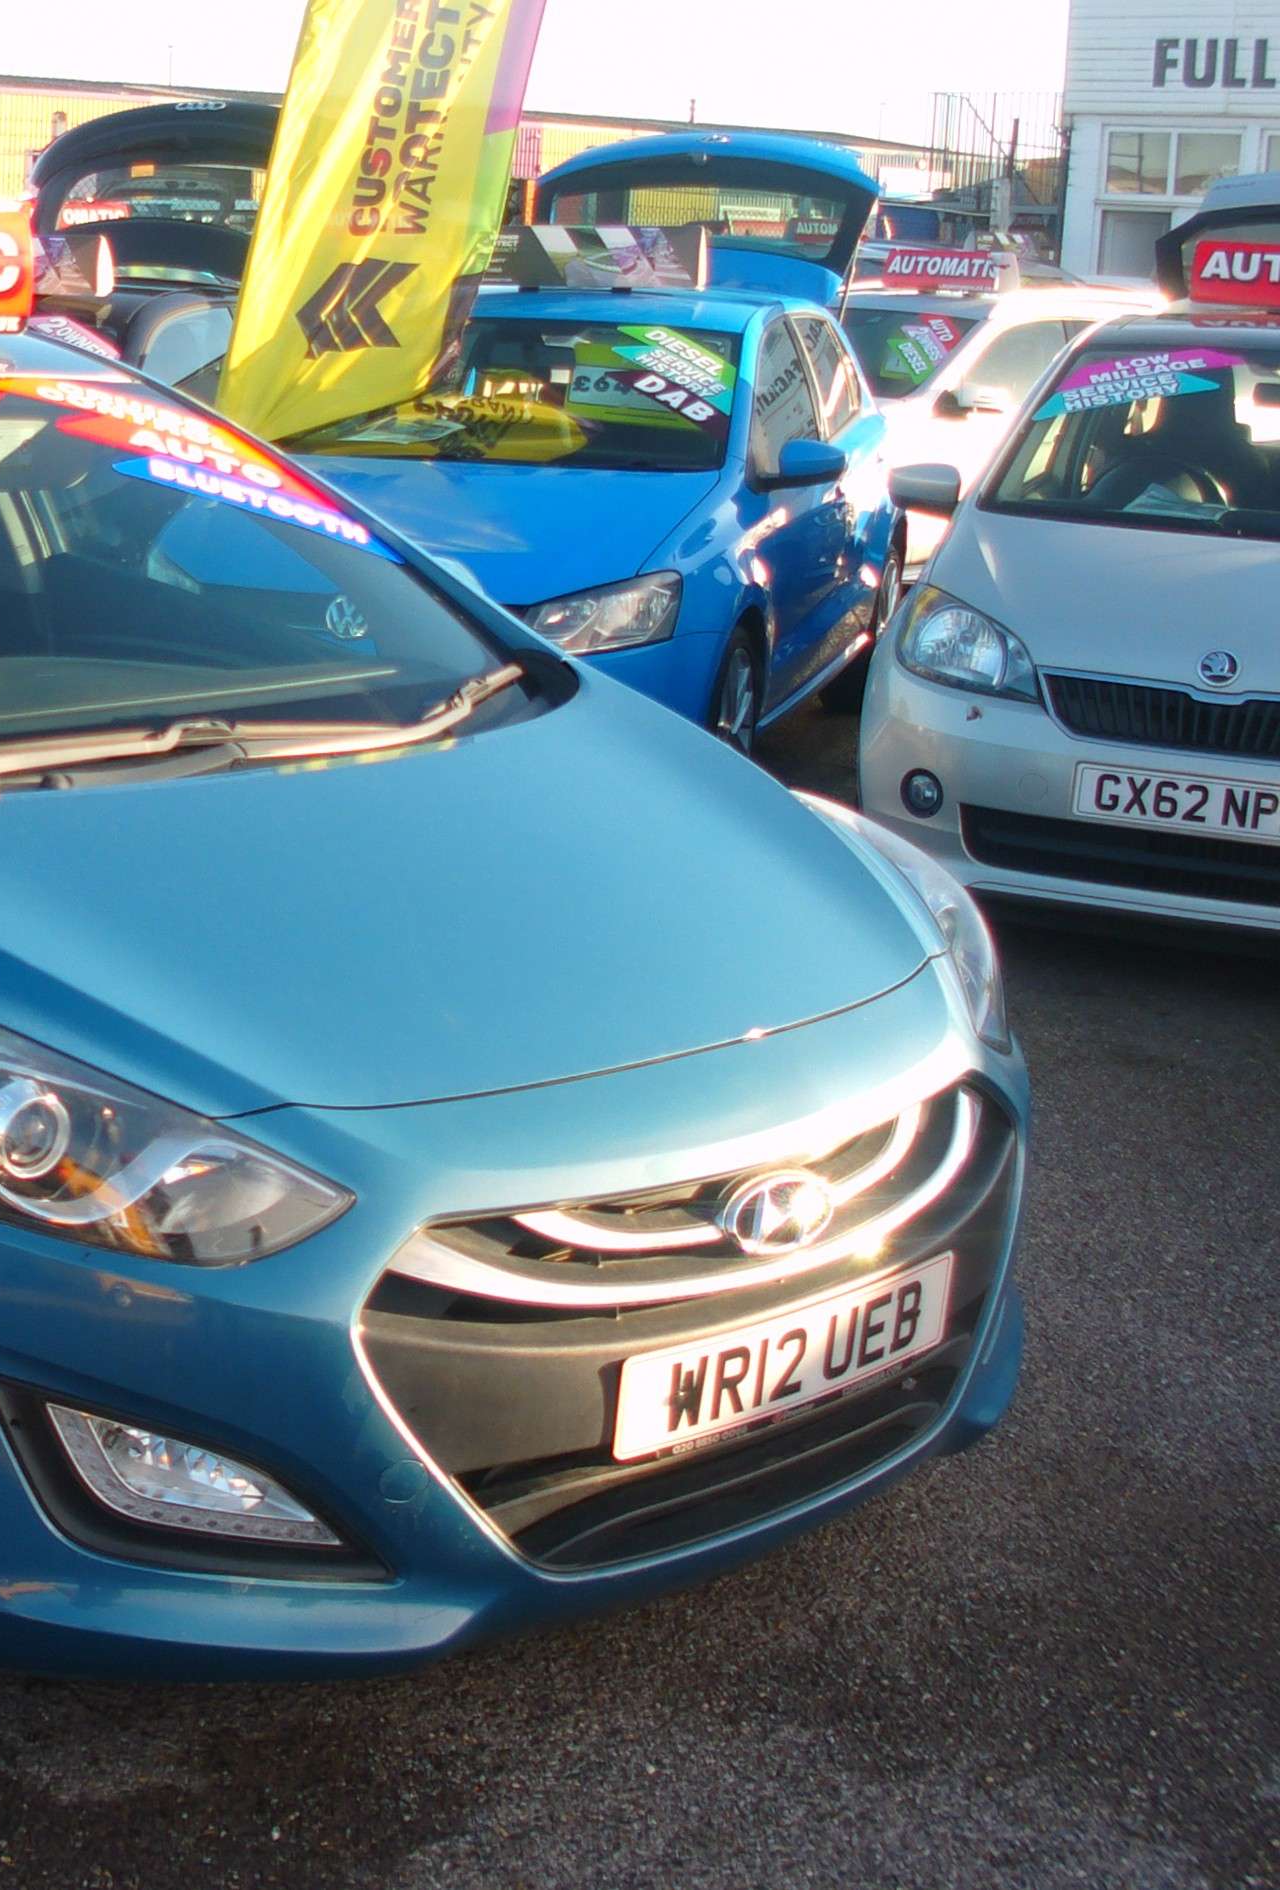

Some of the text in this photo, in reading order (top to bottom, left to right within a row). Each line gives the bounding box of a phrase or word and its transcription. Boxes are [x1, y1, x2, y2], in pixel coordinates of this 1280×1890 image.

[1152, 38, 1277, 88] FULL
[634, 352, 716, 399] HISTORY
[644, 328, 724, 377] DIESEL
[650, 347, 726, 394] SERVICE
[1089, 358, 1207, 384] MILEAGE
[1114, 353, 1170, 371] LOW
[632, 374, 715, 422] DAB
[1061, 373, 1177, 401] SERVICE
[1063, 384, 1181, 411] HISTORY
[128, 429, 283, 489] AUTO
[1093, 773, 1210, 823] GX62
[666, 1280, 922, 1433] WR12 UEB
